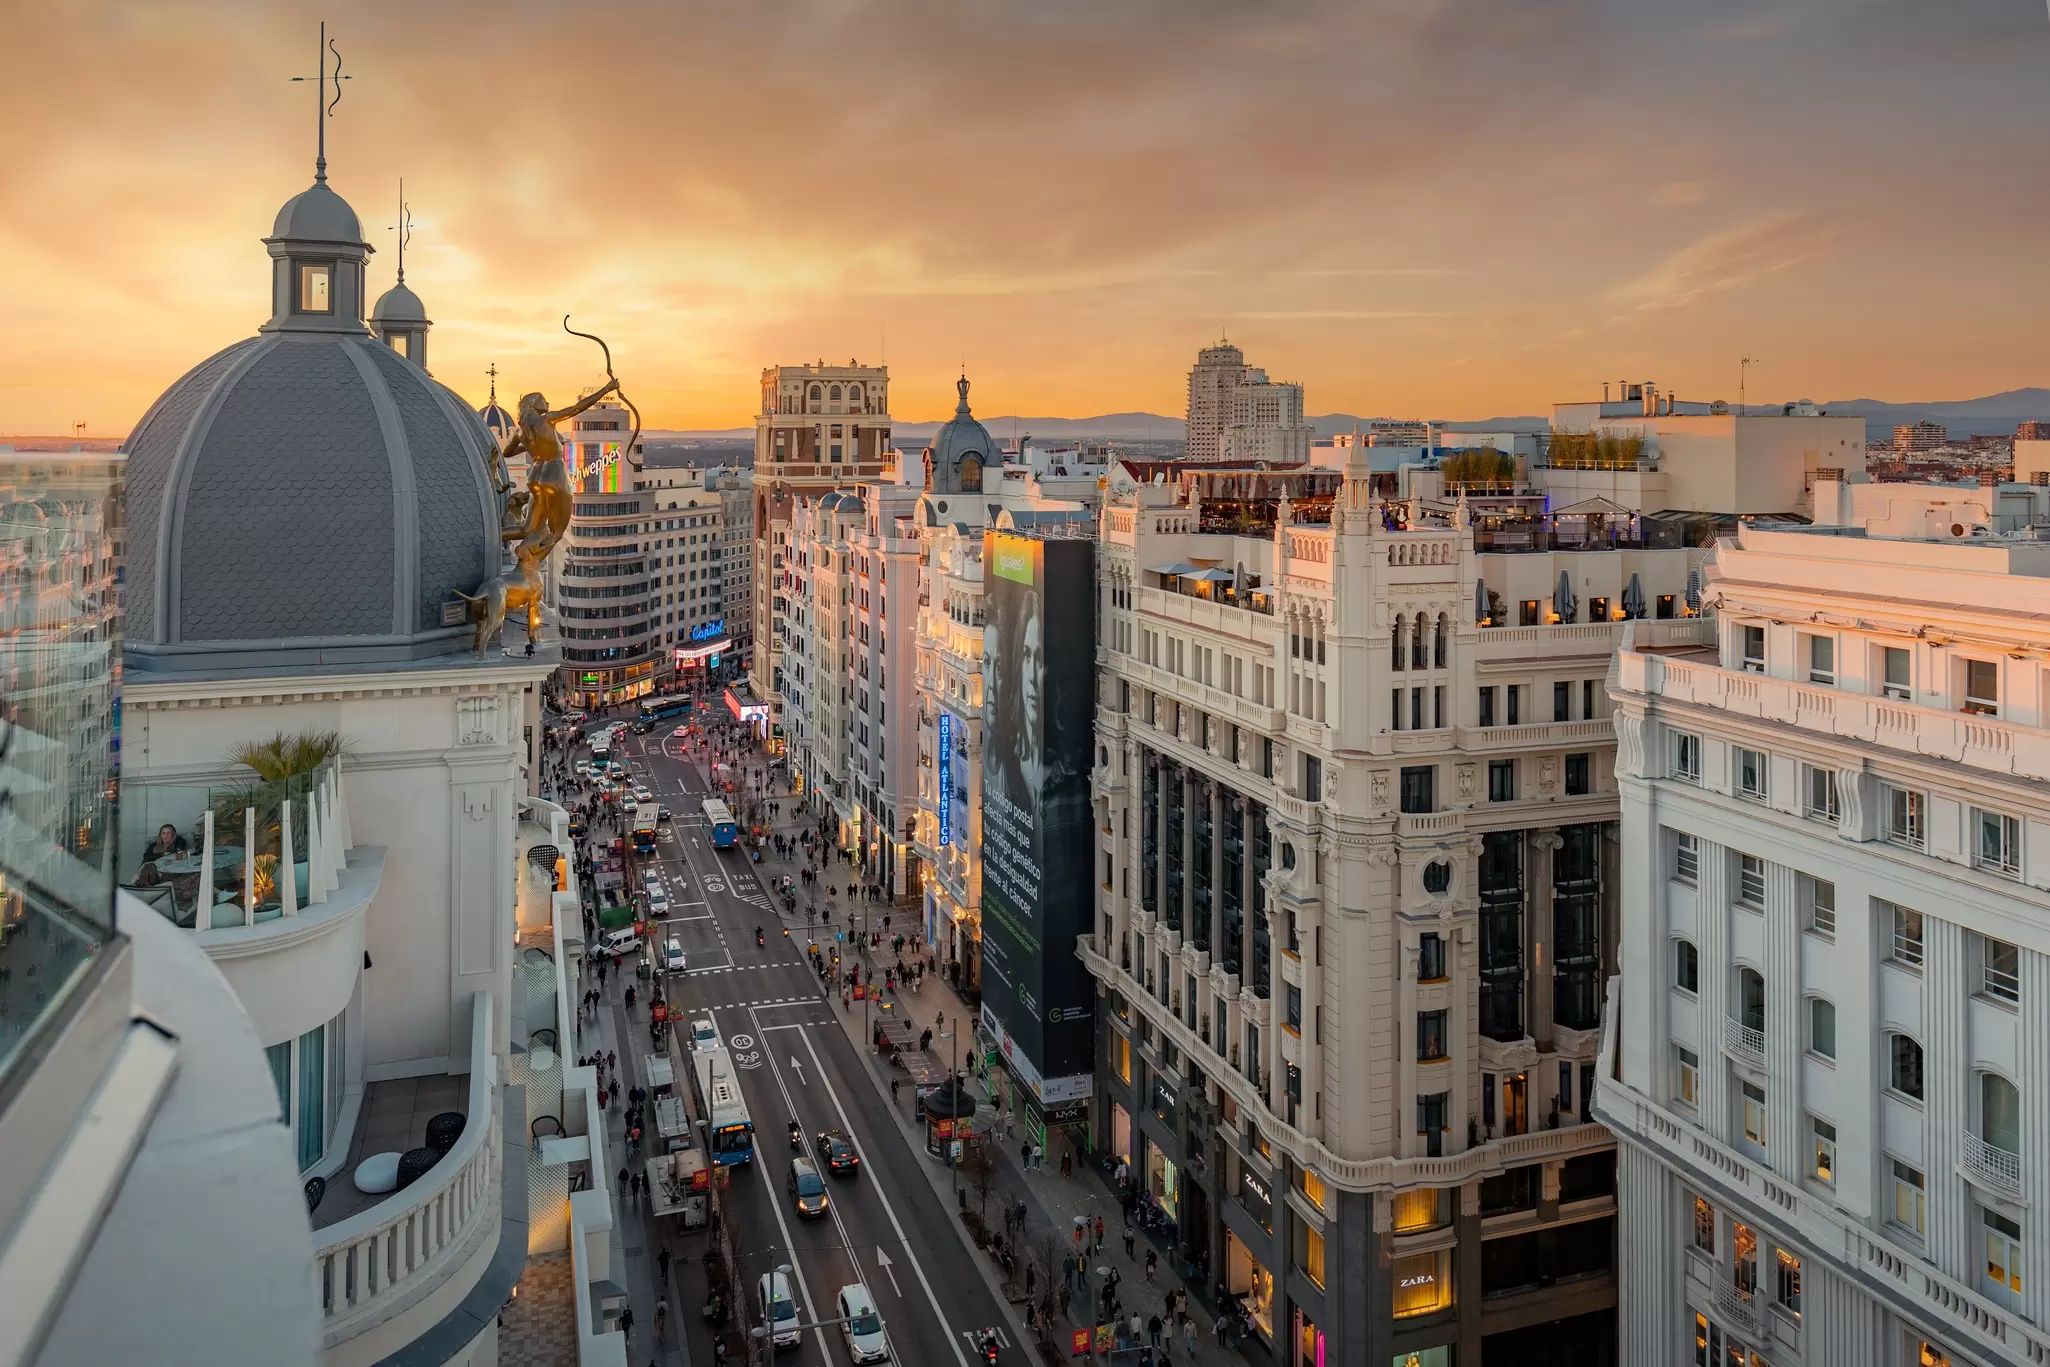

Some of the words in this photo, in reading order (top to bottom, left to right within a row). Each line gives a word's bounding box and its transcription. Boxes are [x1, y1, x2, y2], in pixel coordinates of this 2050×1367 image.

[567, 446, 622, 486] Schweppes
[692, 619, 724, 640] Capitol
[941, 716, 949, 760] HOTEL
[941, 765, 949, 845] ATLANTICO
[984, 778, 992, 796] Tu
[992, 788, 1012, 814] código
[1014, 805, 1034, 830] postal
[984, 802, 1002, 826] afecta
[1003, 818, 1016, 837] más
[1017, 830, 1030, 849] que
[984, 820, 991, 837] tu
[991, 828, 1011, 855] código
[1012, 848, 1041, 880] genético
[739, 883, 757, 891] BUS
[984, 843, 991, 857] en
[992, 846, 999, 864] la
[999, 855, 1038, 901] desigualdad
[984, 859, 1001, 887] frente
[1002, 880, 1008, 895] al
[1009, 888, 1032, 918] cáncer.
[1055, 1109, 1078, 1119] NYX
[1160, 1085, 1175, 1107] ZAR
[1245, 1173, 1272, 1205] ZARA
[1400, 1274, 1434, 1287] ZARA
